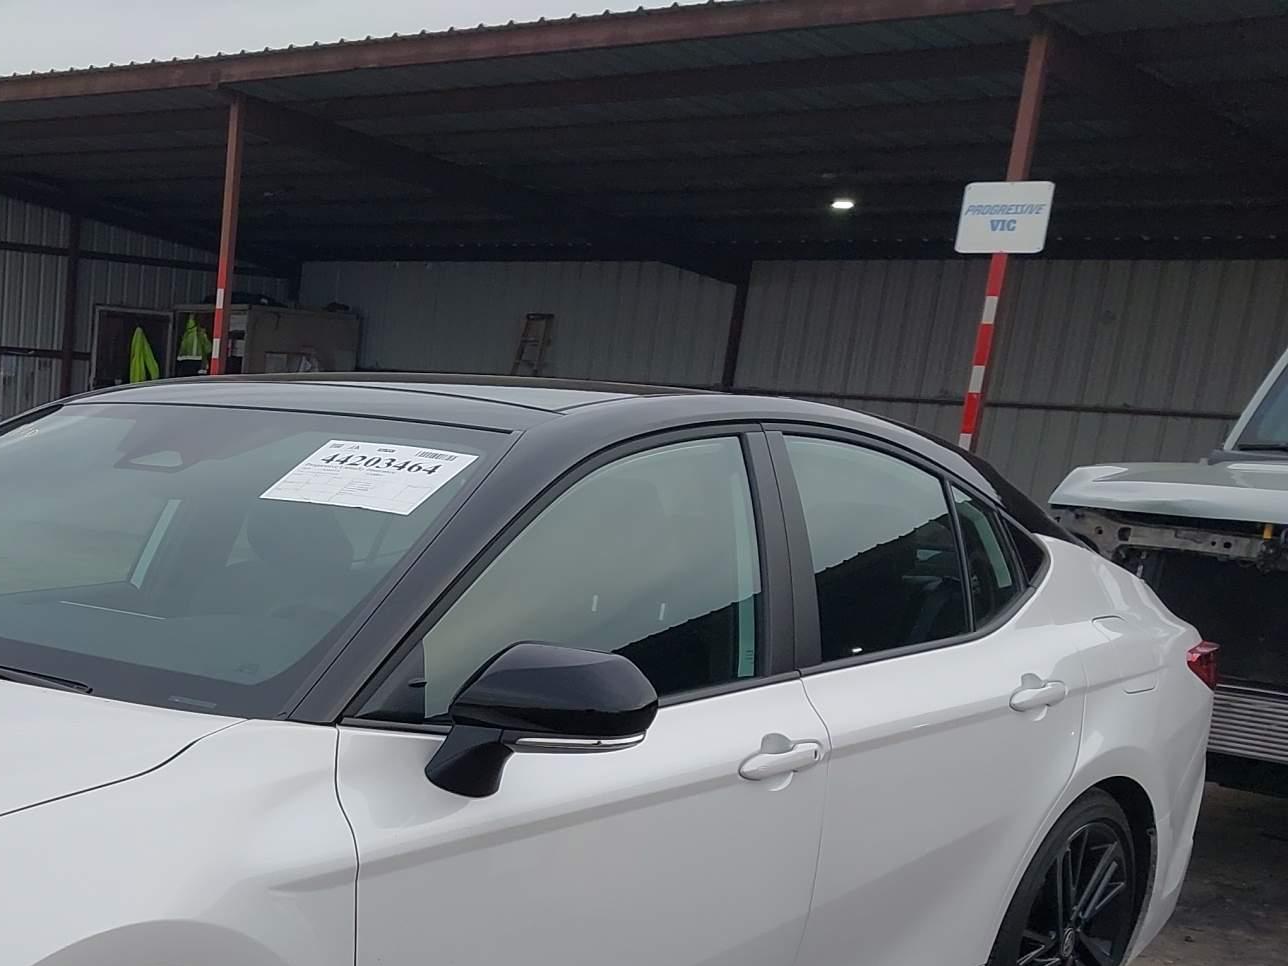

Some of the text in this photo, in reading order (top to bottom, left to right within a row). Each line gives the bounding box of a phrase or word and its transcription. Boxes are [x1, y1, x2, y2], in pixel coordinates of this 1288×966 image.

[964, 203, 1046, 216] PROGRESSIVE
[989, 219, 1017, 232] VIC
[320, 453, 442, 475] 44203464
